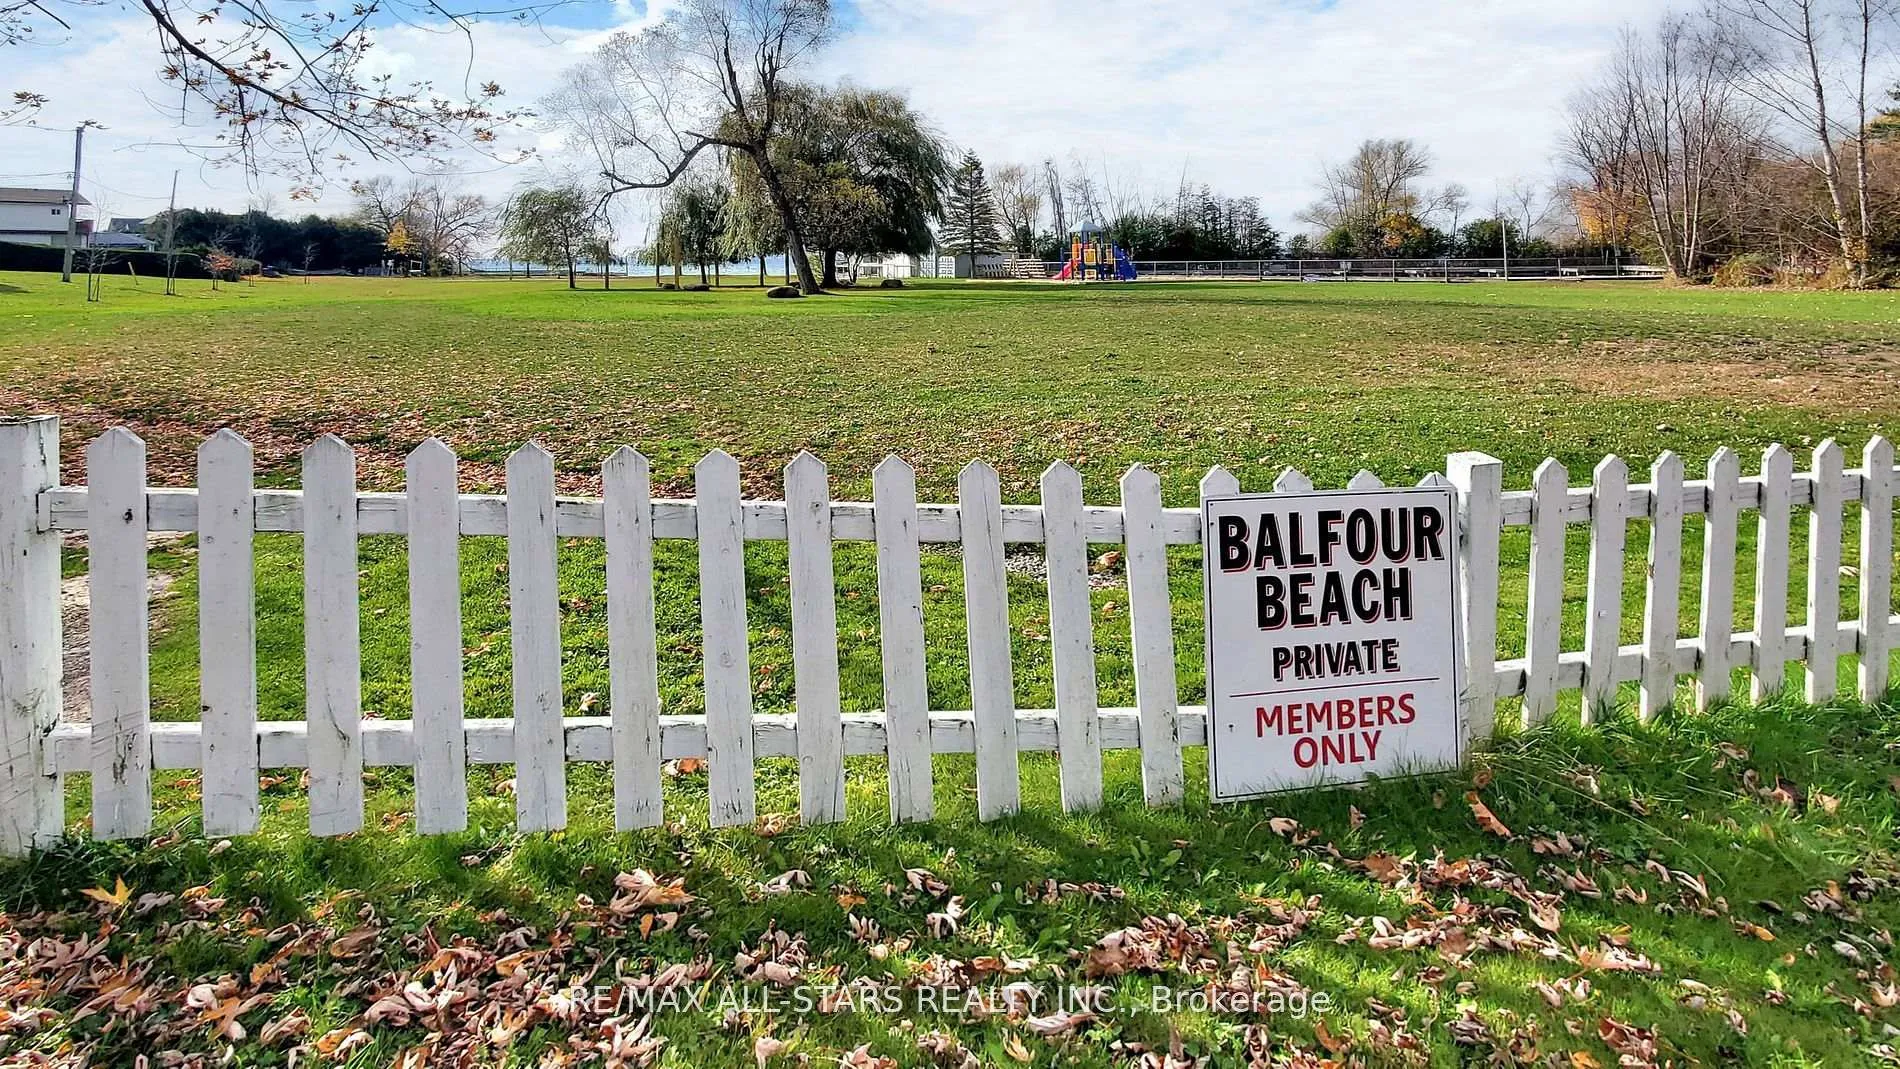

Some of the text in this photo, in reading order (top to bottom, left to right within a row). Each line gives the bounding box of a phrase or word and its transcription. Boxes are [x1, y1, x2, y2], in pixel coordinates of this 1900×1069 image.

[1218, 506, 1445, 572] BALFOUR
[1256, 567, 1413, 631] BEACH
[1272, 638, 1400, 682] PRIVATE
[1255, 693, 1416, 738] MEMBERS
[1293, 730, 1382, 769] ONLY
